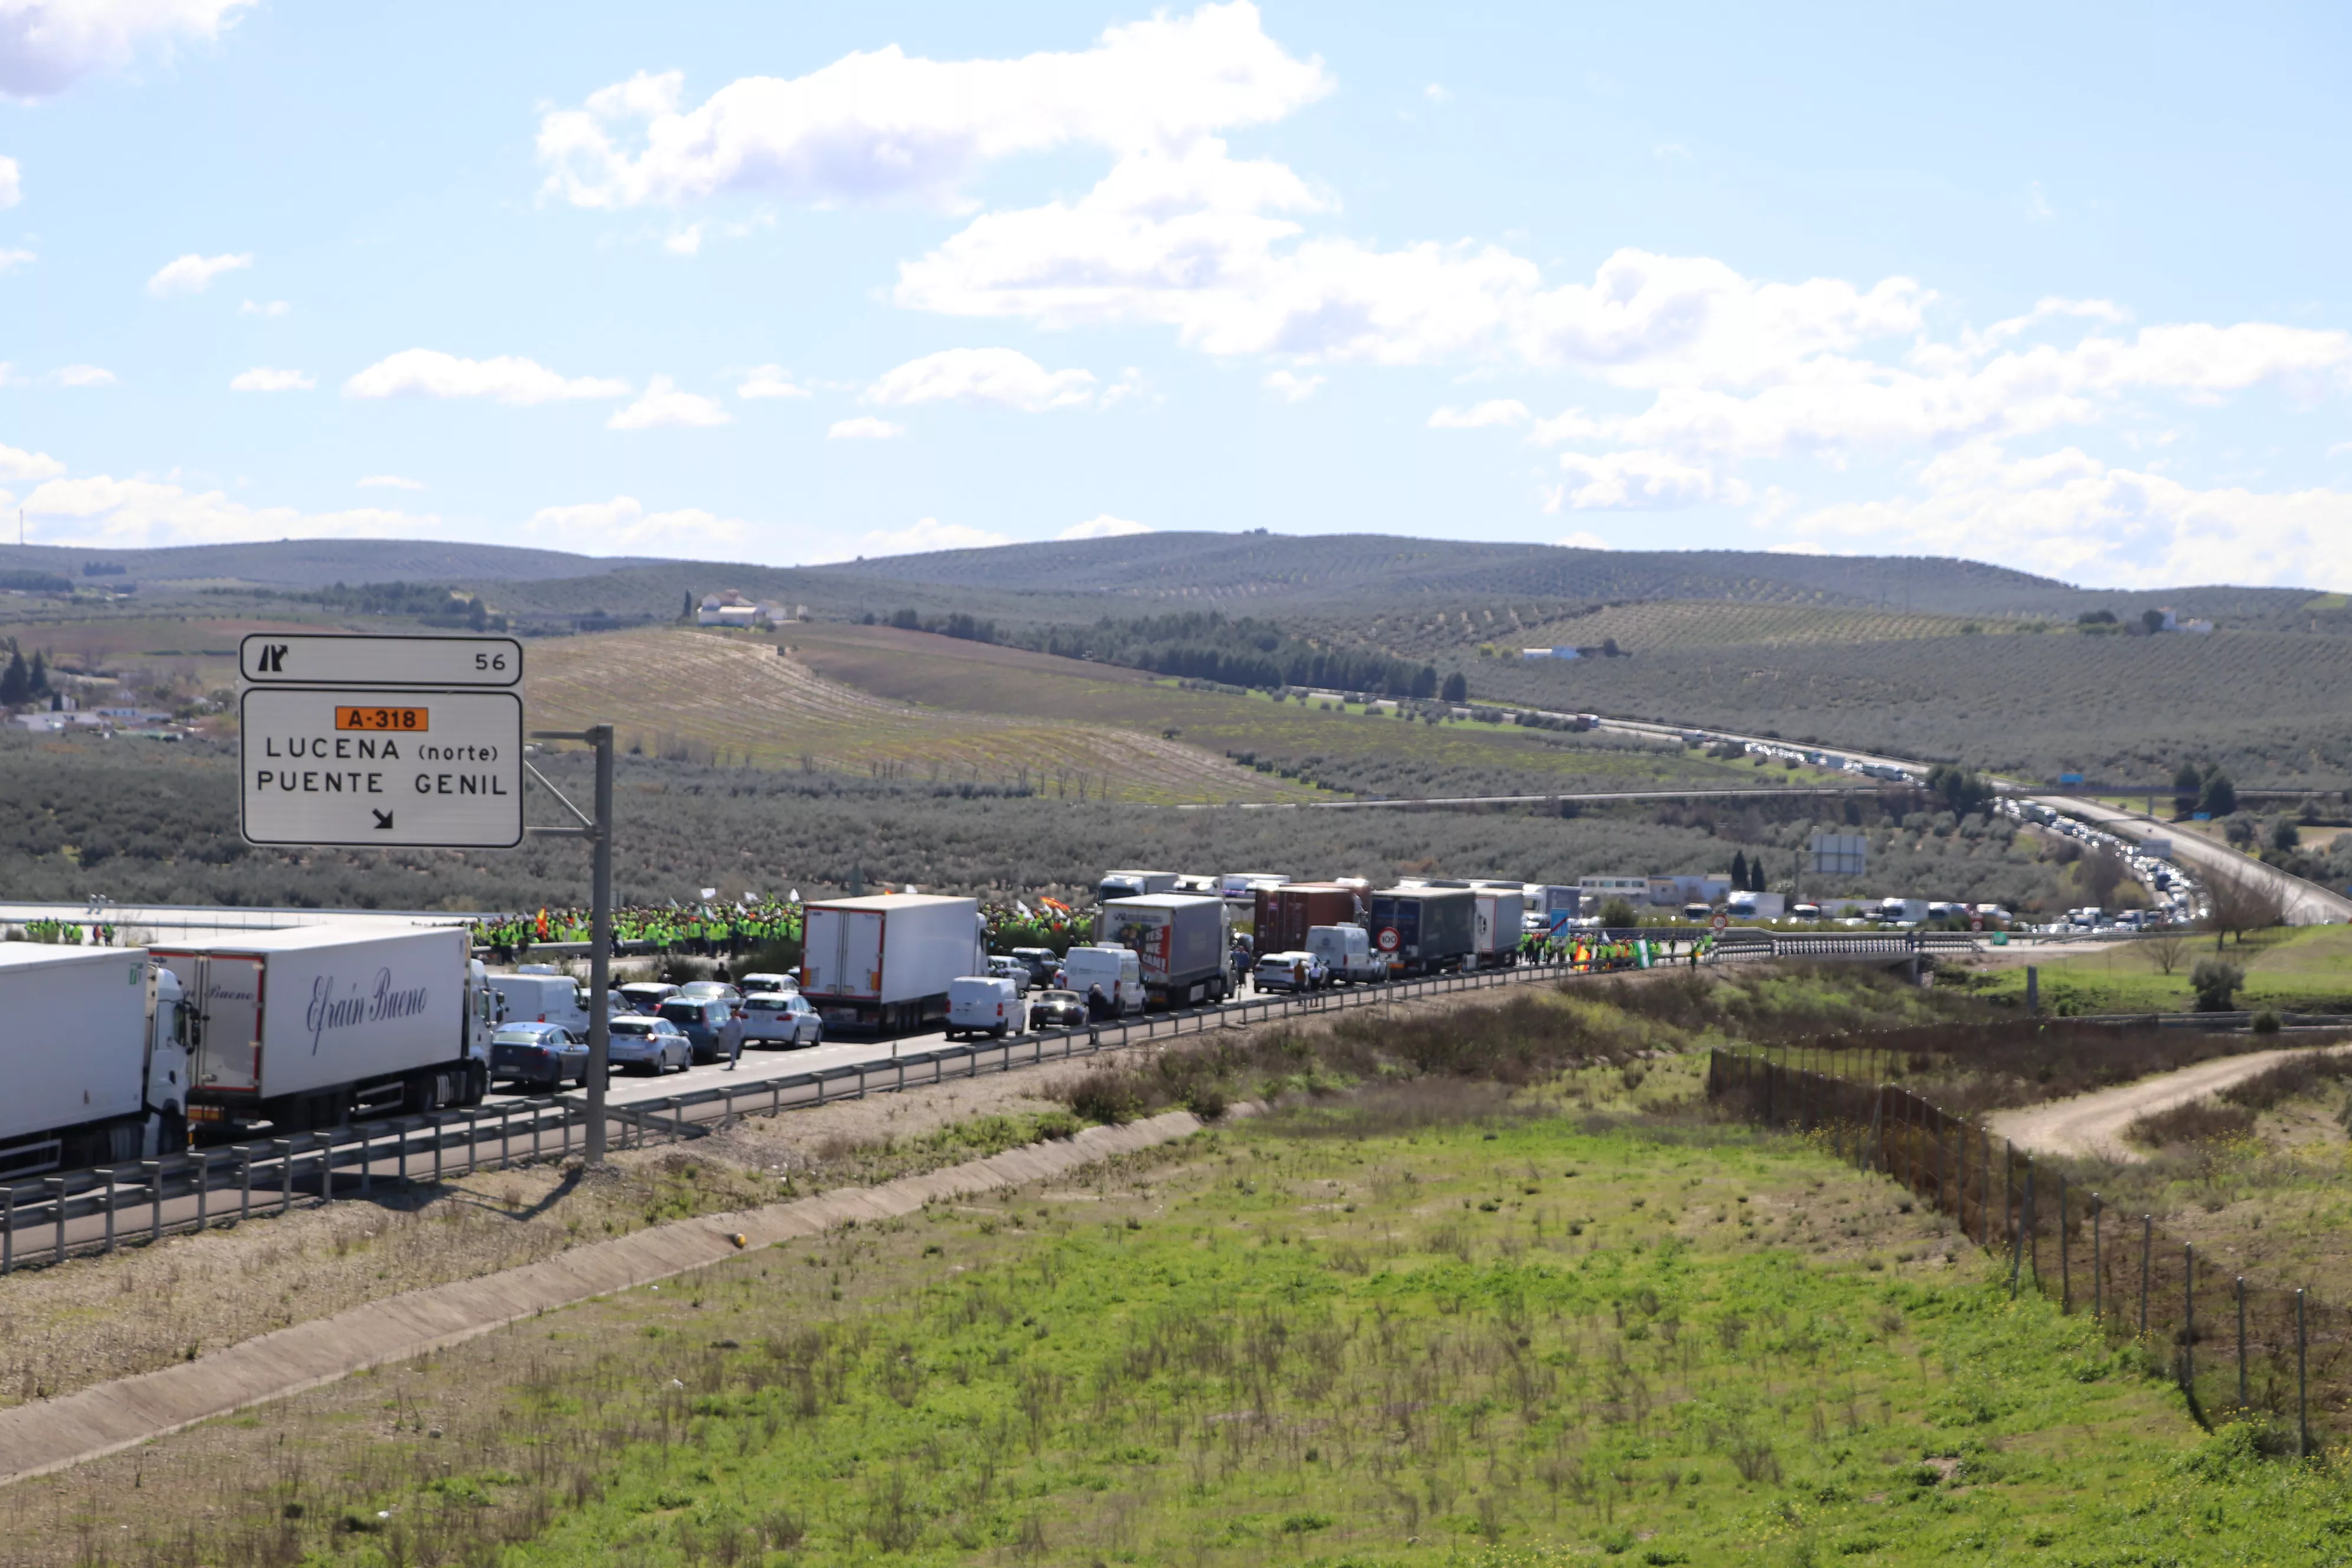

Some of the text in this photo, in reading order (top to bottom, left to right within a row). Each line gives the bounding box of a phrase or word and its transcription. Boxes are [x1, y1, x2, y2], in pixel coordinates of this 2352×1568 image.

[475, 654, 506, 671] 56
[348, 710, 417, 729] A-318
[267, 737, 498, 762] LUCENA (norte)
[258, 770, 507, 795] PUENTE GENIL
[1146, 928, 1163, 941] YES
[1381, 935, 1397, 943] 100
[1146, 942, 1161, 955] WE
[369, 966, 428, 1021] Bueno
